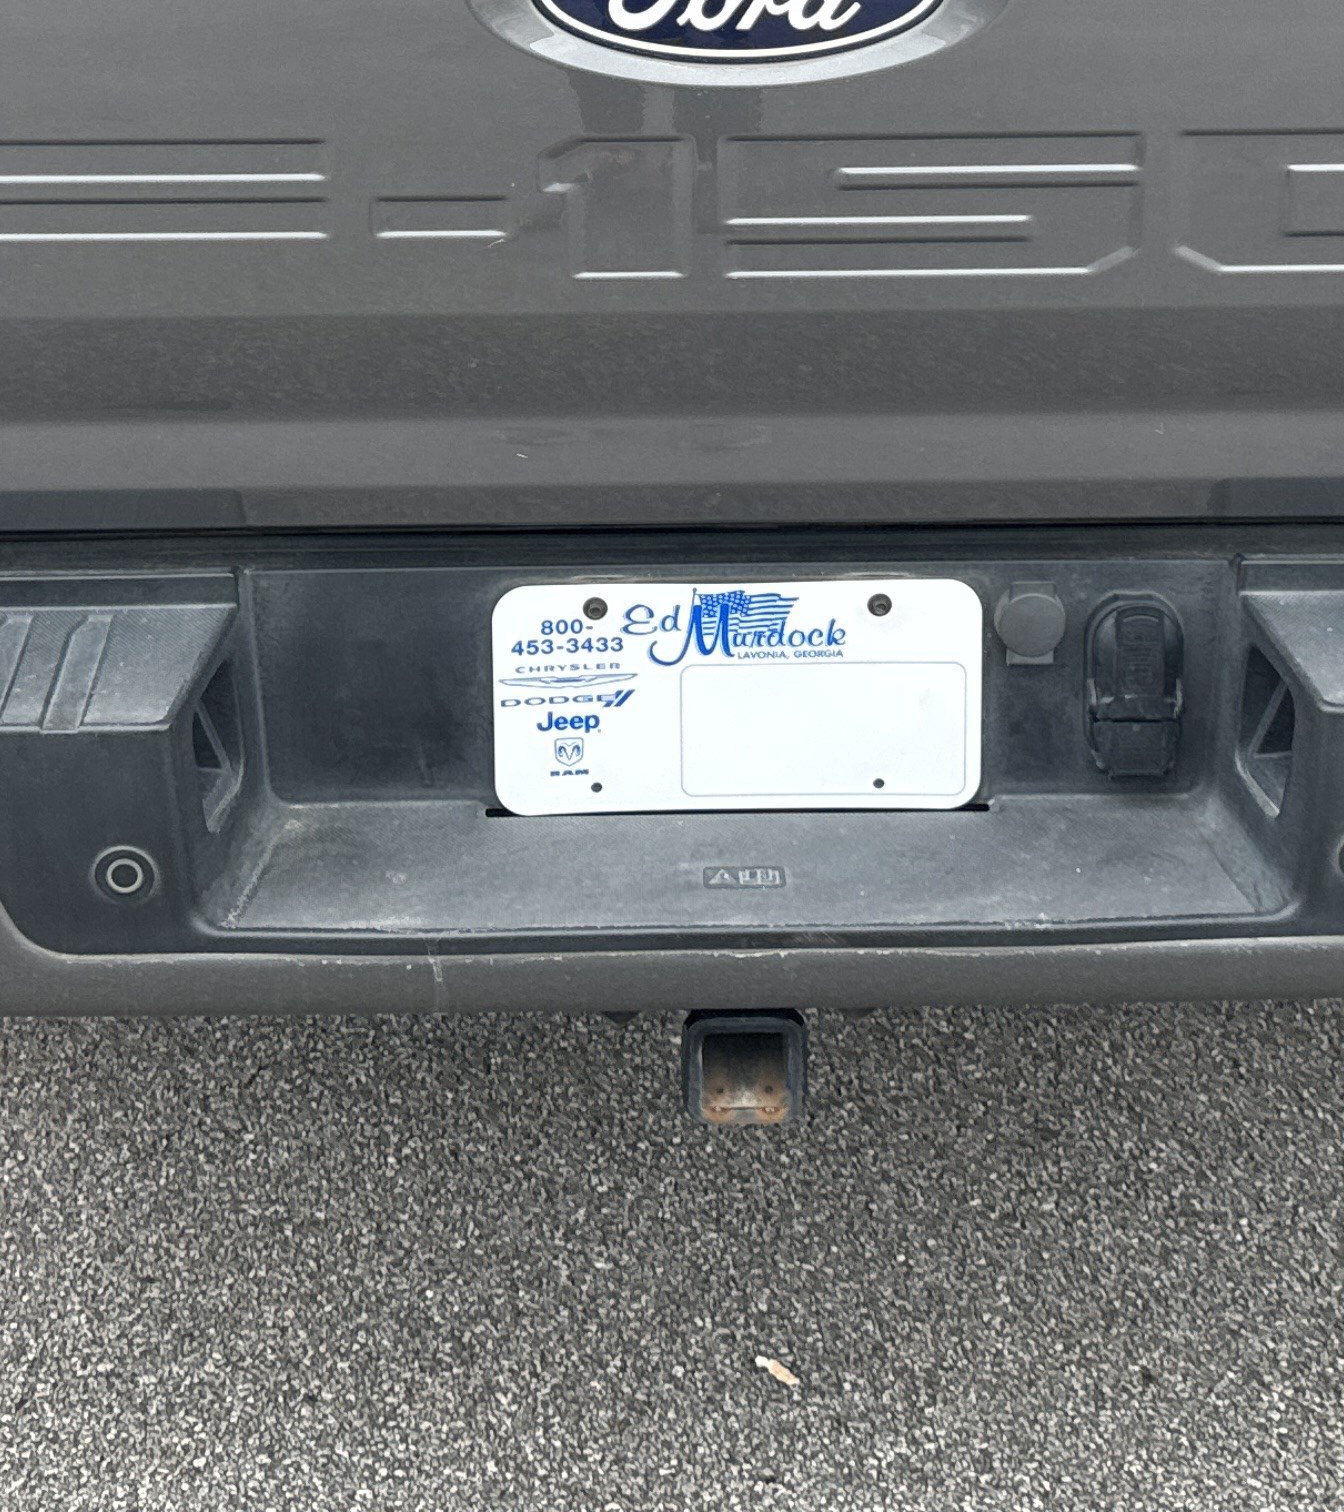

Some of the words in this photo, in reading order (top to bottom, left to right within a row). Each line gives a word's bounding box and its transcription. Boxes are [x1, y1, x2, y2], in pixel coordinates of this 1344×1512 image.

[540, 618, 594, 636] 800-
[621, 603, 682, 636] Ed
[647, 603, 846, 666] Murdock
[510, 636, 624, 656] 453-3433
[737, 649, 790, 660] LAVONIA,
[793, 648, 844, 659] GEORGIA
[514, 662, 621, 674] CHRYSLER
[536, 711, 600, 733] Jeep
[549, 768, 590, 777] RAM
